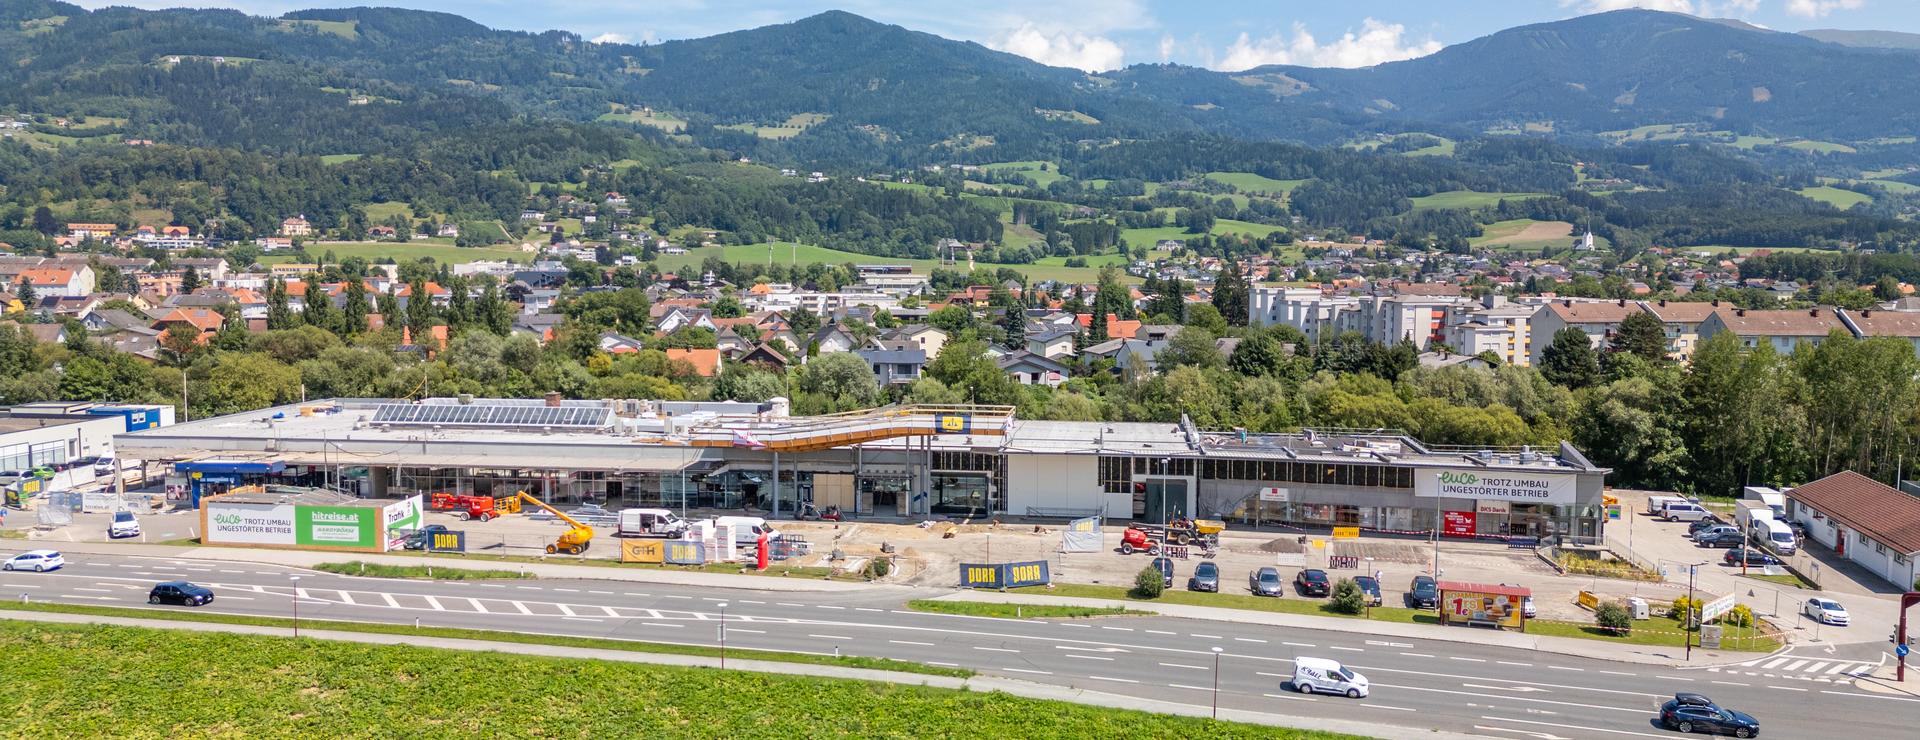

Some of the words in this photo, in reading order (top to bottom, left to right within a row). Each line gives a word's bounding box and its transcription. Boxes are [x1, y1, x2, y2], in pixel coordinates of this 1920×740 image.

[1439, 471, 1479, 485] euco
[1481, 478, 1511, 487] TROTZ
[1513, 479, 1549, 489] UMBAU
[1442, 485, 1508, 496] UNGESTÖRTER
[1511, 488, 1549, 498] BETRIEB
[214, 514, 242, 524] euco
[312, 511, 360, 521] hitreise.at
[388, 509, 405, 523] Trafik
[217, 525, 264, 533] UNGESTÖRTER
[968, 567, 996, 584] PORR
[1012, 564, 1041, 583] PORR
